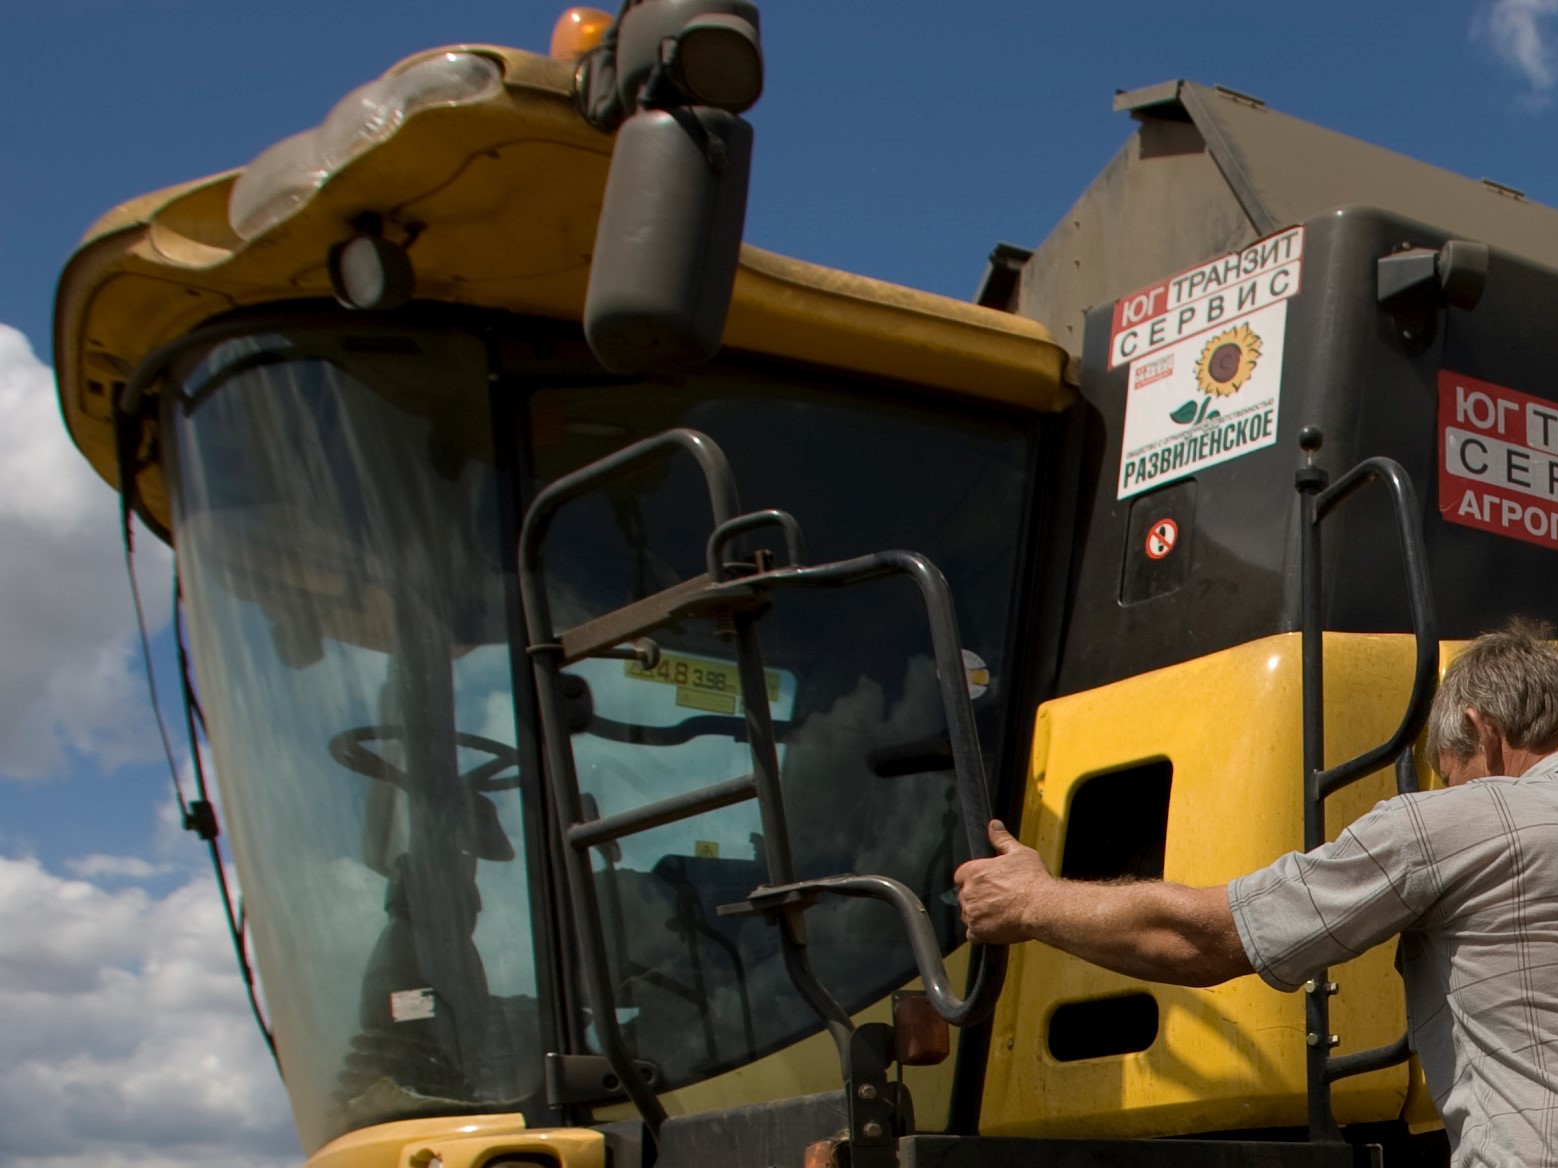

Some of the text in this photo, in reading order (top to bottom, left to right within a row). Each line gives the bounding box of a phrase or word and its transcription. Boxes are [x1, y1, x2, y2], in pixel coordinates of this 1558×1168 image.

[1120, 269, 1289, 358] СЕРВИС
[1121, 231, 1298, 326] ЮГ ТРАНЗИТ
[1123, 409, 1273, 488] РАЗВИЛЕНСКОЕ
[1456, 386, 1519, 434] ЮГ
